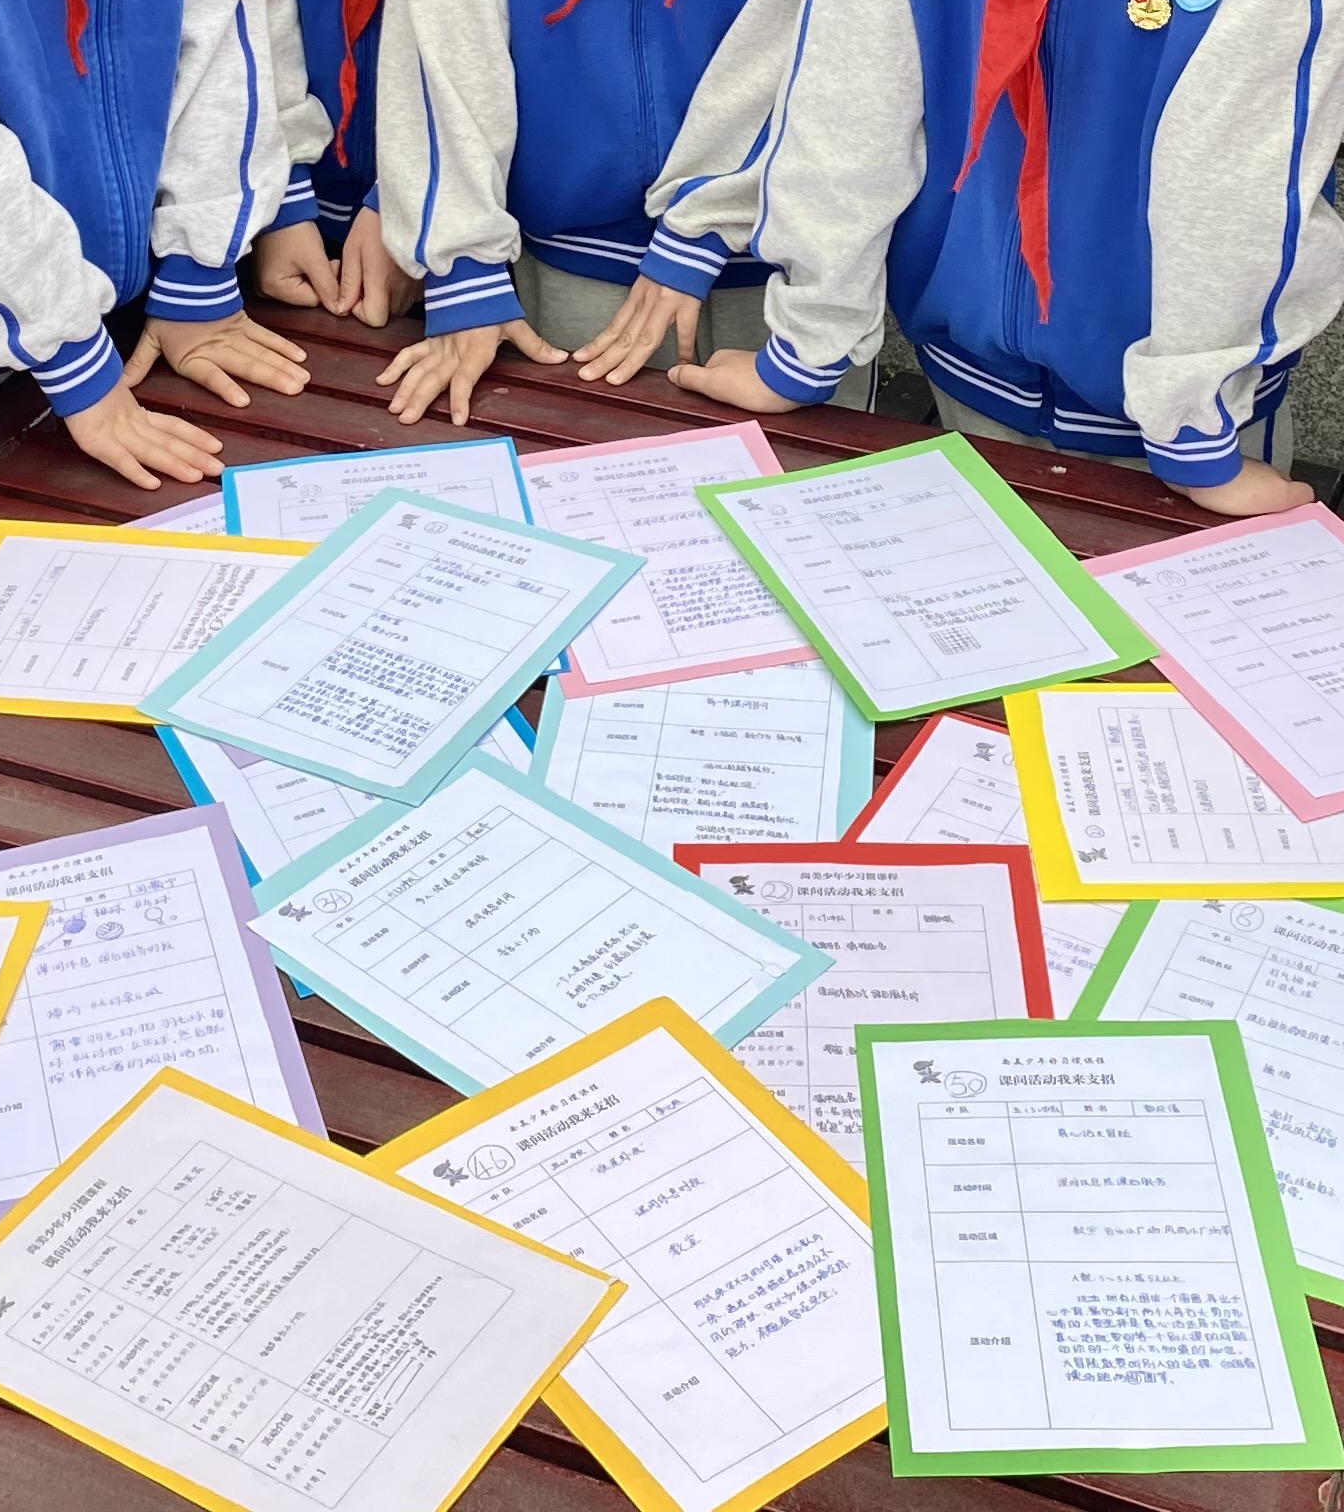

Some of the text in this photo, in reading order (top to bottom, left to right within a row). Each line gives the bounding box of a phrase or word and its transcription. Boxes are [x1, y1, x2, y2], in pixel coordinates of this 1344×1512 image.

[348, 830, 432, 887] 课间活动我来支招
[7, 867, 113, 896] 课间活动我来支招
[797, 887, 904, 897] 课间活动我来支招
[951, 1076, 983, 1096] 50
[999, 1074, 1115, 1086] 课间活动我来支招
[516, 1093, 620, 1152] 课间活动我来支招
[474, 1150, 507, 1178] 46
[490, 1186, 513, 1201] 中队
[954, 1184, 992, 1192] 活动时间
[42, 1185, 132, 1269] 课间活动我来支招
[513, 1207, 548, 1230] 活动名称
[63, 1310, 95, 1341] 活动名称
[117, 1337, 149, 1370] 活动时间
[189, 1374, 220, 1408] 活动区域
[662, 1375, 700, 1401] 活动介绍
[262, 1413, 293, 1447] 活动介绍
